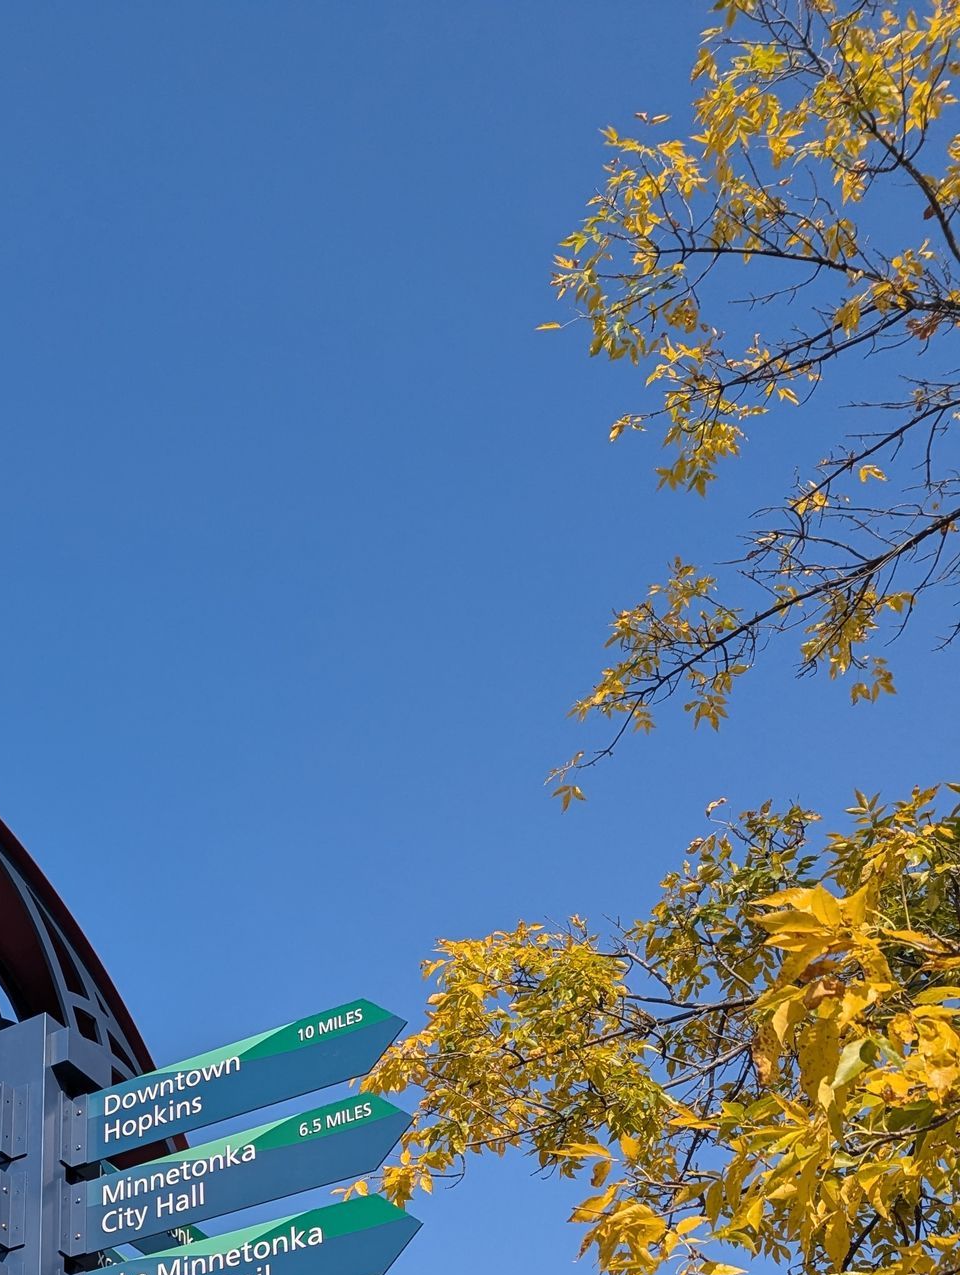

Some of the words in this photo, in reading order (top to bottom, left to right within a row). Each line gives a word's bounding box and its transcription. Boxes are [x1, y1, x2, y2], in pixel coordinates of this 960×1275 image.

[298, 1025, 314, 1041] 10
[318, 1008, 363, 1034] MILES
[103, 1055, 241, 1116] Downtown
[103, 1096, 202, 1143] Hopkins
[299, 1119, 321, 1137] 6.5
[326, 1103, 372, 1129] MILES
[101, 1143, 257, 1206] Minnetonka
[101, 1204, 149, 1233] City
[156, 1182, 205, 1218] Hall
